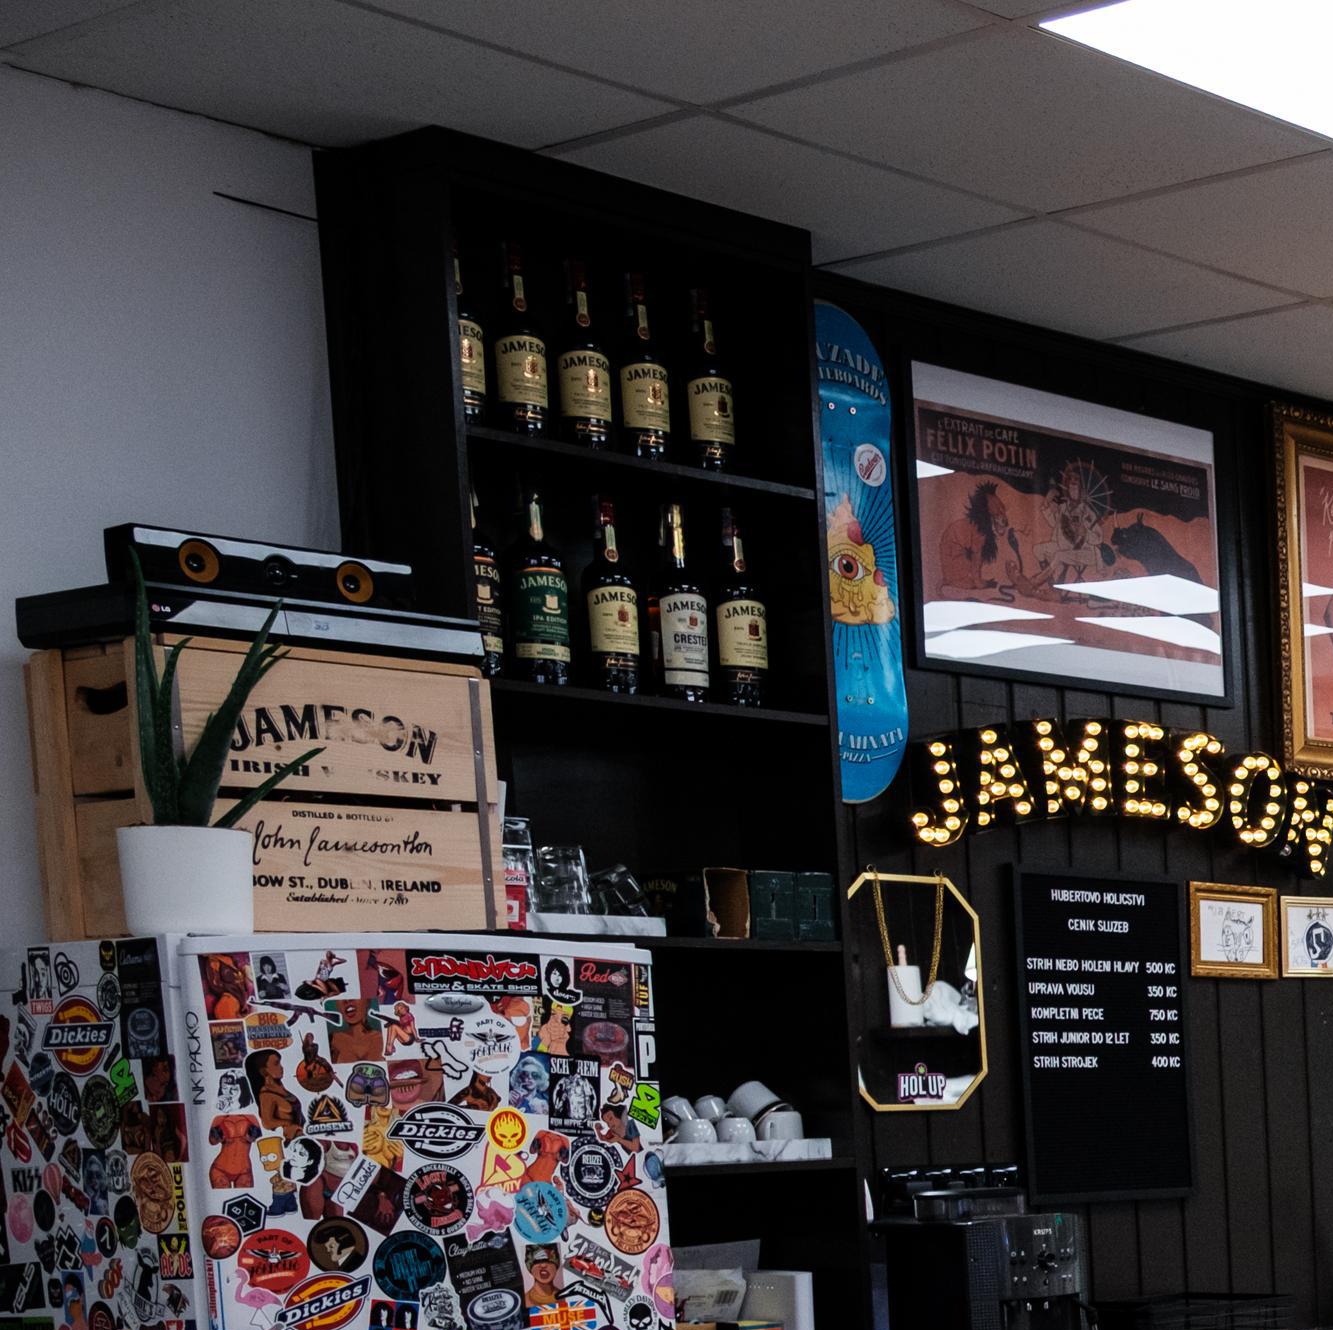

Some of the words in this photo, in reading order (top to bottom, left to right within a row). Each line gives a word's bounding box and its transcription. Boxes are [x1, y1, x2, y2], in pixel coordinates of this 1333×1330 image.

[983, 441, 1037, 470] POTIN
[673, 633, 708, 645] CRESTE
[291, 809, 335, 820] DISTILLED
[318, 877, 377, 891] DUBLN,
[381, 879, 442, 893] IRELAND
[1051, 888, 1100, 904] HUBERTOVO
[1103, 891, 1145, 906] HOLICSTVI
[1068, 919, 1095, 931] CENIK
[1097, 920, 1129, 933] SLUZEB
[580, 962, 608, 983] Red
[1026, 957, 1053, 971] STRIH
[1055, 958, 1079, 972] NEBO
[1081, 959, 1111, 973] HOLENI
[1112, 961, 1139, 974] HLAVY
[1145, 961, 1163, 974] 500
[1164, 962, 1176, 975] KC
[414, 981, 450, 991] SNOW
[451, 981, 465, 991] &
[466, 983, 506, 991] SKATE
[508, 983, 538, 991] SHOP
[1028, 982, 1064, 996] UPRAVA
[1066, 983, 1095, 996] VOUSU
[1147, 985, 1163, 998] 350
[1165, 985, 1177, 998] KC
[258, 1013, 278, 1025] BIG
[1031, 1006, 1080, 1020] KOMPLETNI
[1082, 1007, 1104, 1020] PECE
[1149, 1008, 1165, 1021] 750
[1166, 1009, 1178, 1021] KC
[476, 1018, 494, 1029] PART
[496, 1020, 506, 1029] OF
[50, 1028, 107, 1044] Dickies
[1032, 1031, 1058, 1044] STRIH
[1060, 1031, 1090, 1044] JUNIOR
[1091, 1032, 1104, 1045] DO
[1105, 1032, 1113, 1045] 12
[1114, 1032, 1130, 1045] LET
[1150, 1032, 1166, 1045] 350
[1168, 1032, 1180, 1045] KC
[1033, 1055, 1060, 1069] STRIH
[1062, 1056, 1098, 1069] STROJEK
[1151, 1055, 1167, 1068] 400
[1169, 1056, 1181, 1068] KC
[610, 1070, 633, 1090] RUSH
[400, 1123, 478, 1140] Dickies
[11, 1168, 42, 1193] KISS
[173, 1165, 186, 1223] POLICE
[285, 1284, 364, 1323] Dickies
[543, 1309, 585, 1325] MUSE
